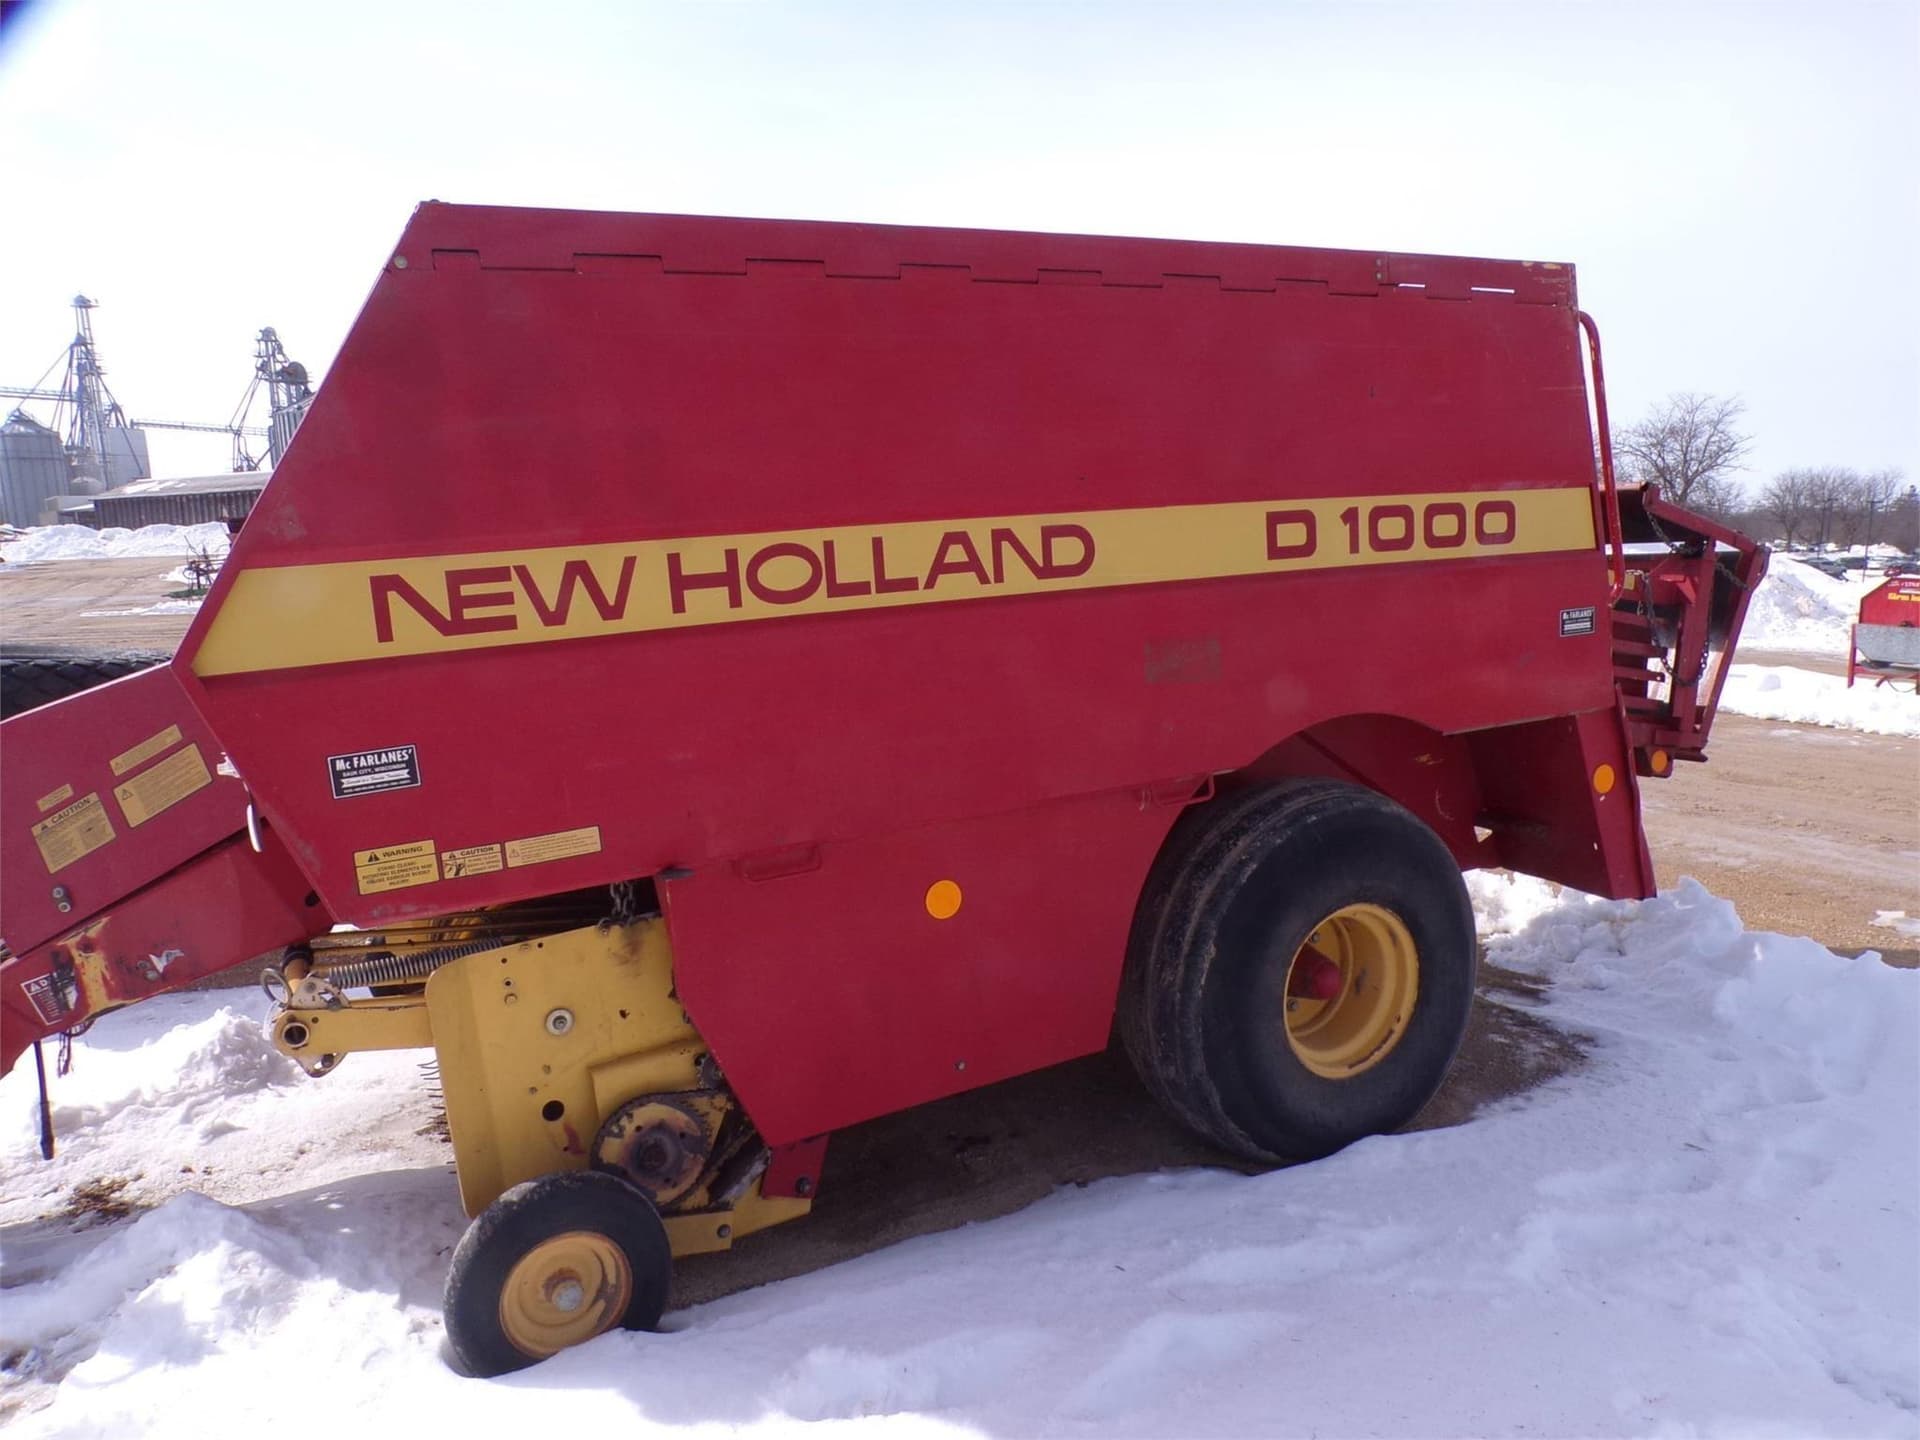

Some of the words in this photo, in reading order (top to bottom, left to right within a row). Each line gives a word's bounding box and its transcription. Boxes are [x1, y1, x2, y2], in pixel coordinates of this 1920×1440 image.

[1266, 509, 1318, 561] D
[1340, 500, 1516, 555] 1000
[369, 555, 638, 643] NEW
[666, 523, 1096, 614] HOLLAND
[335, 759, 351, 771] Mc
[352, 748, 413, 768] FARLANES'
[51, 797, 91, 823] CAUTION
[383, 846, 424, 858] WARNING
[460, 847, 494, 857] CAUTION
